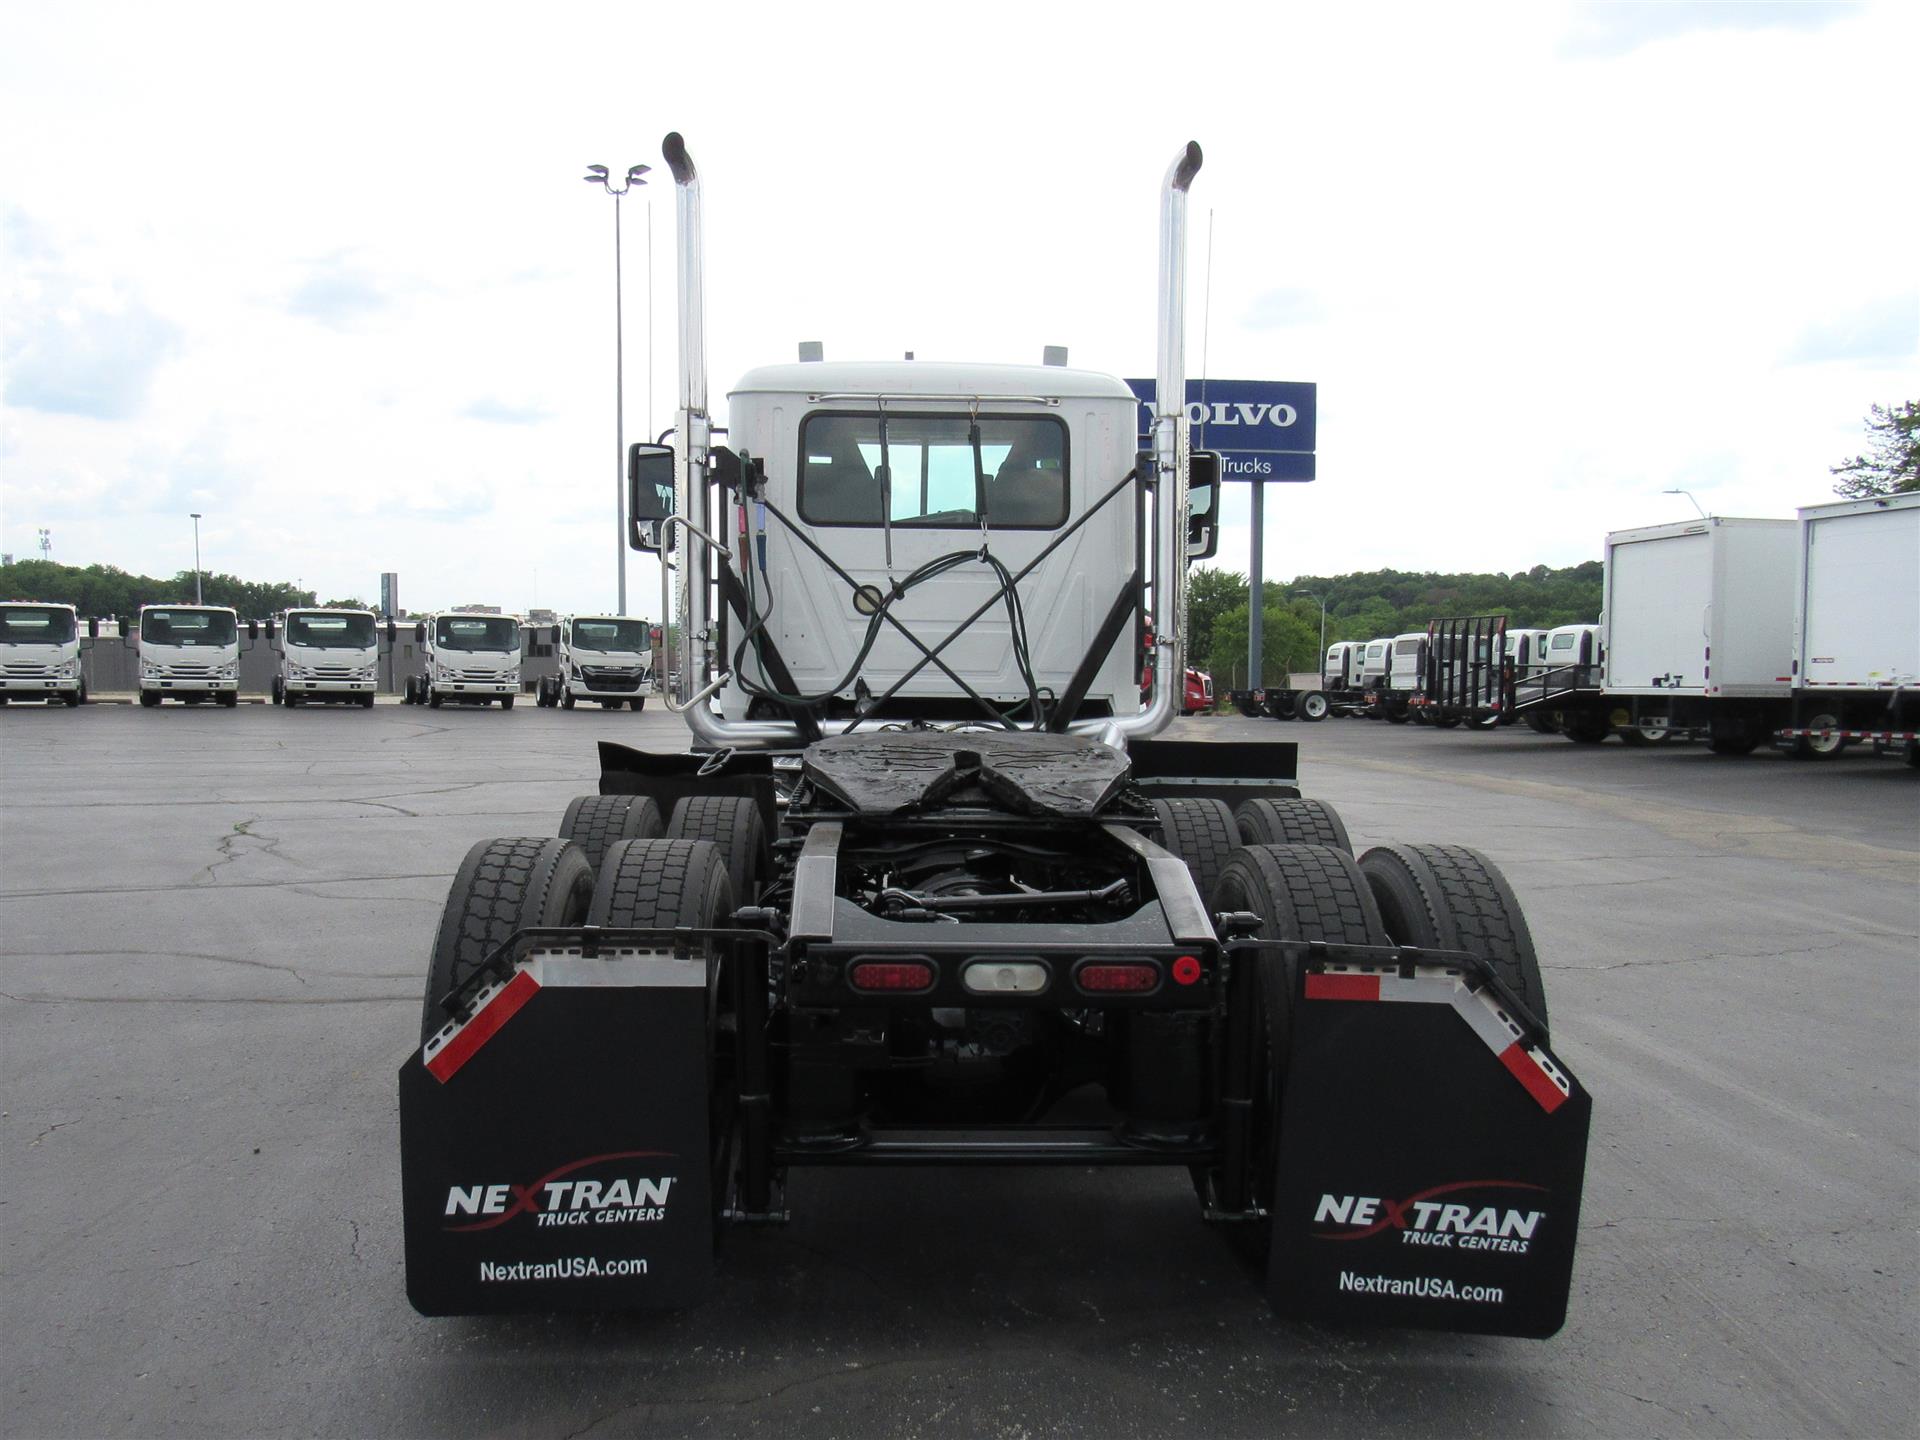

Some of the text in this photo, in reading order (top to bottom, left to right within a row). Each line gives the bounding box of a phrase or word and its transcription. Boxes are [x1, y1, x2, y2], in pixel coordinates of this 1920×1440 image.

[1221, 457, 1272, 474] Trucks
[445, 1177, 671, 1215] NEXTRAN
[537, 1208, 665, 1226] TRUCK CENTERS
[1314, 1194, 1540, 1239] NEXTRAN
[1402, 1230, 1529, 1253] TRUCK CENTERS
[480, 1257, 648, 1282] NextranUSA.com
[1339, 1271, 1503, 1303] NextranUSA.com
